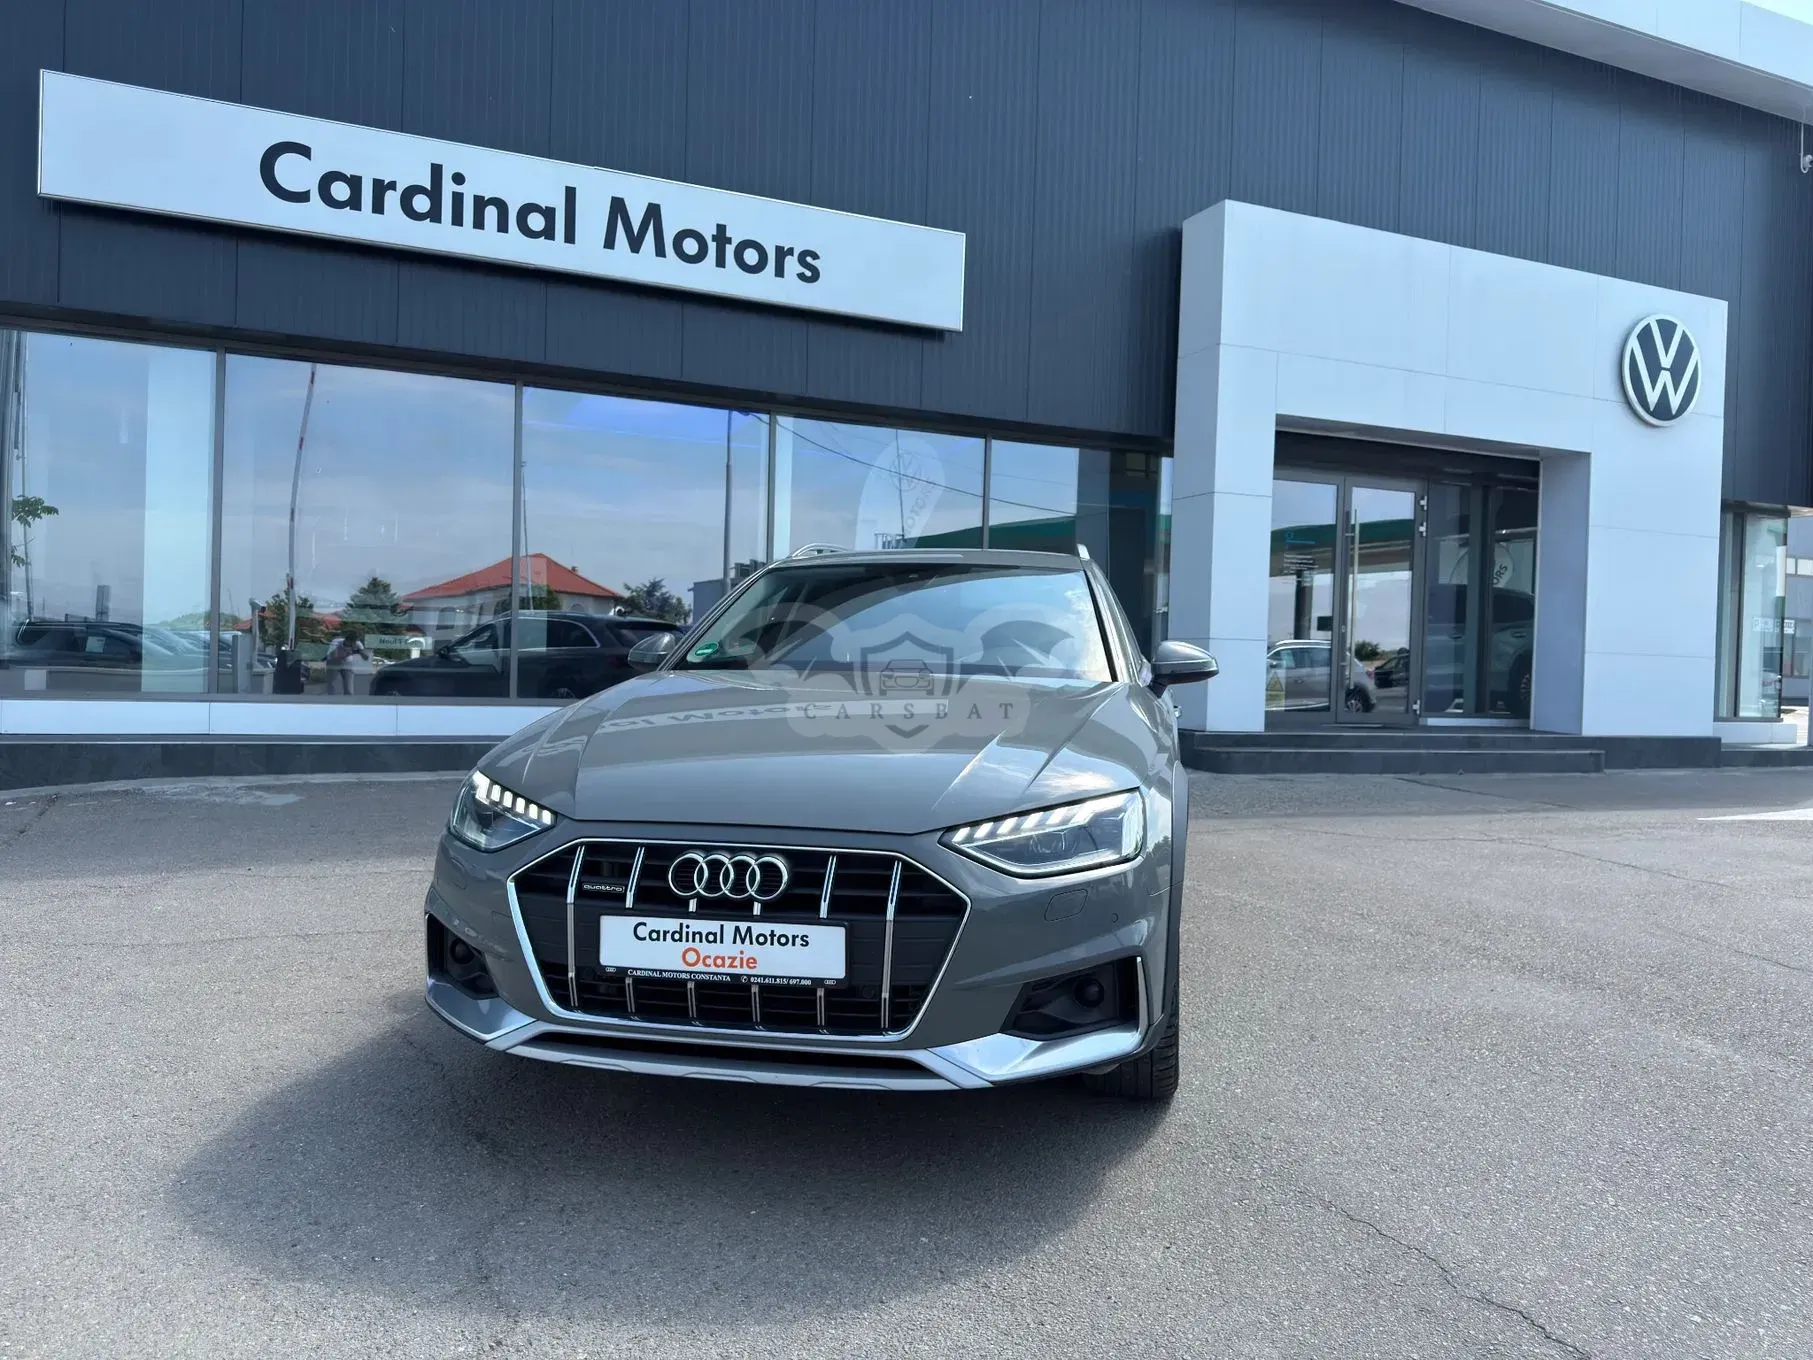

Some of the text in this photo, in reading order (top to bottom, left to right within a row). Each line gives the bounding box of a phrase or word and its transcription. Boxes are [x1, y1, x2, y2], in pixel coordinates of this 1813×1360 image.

[259, 141, 821, 284] Cardinal Motors
[1625, 315, 1700, 424] VW
[583, 884, 623, 892] quattro
[633, 921, 810, 948] Cardinal Motors
[681, 946, 758, 970] Ocazie
[627, 969, 661, 977] CARDINAL
[662, 971, 691, 979] MOTORS
[691, 973, 731, 981] CONSTANTA
